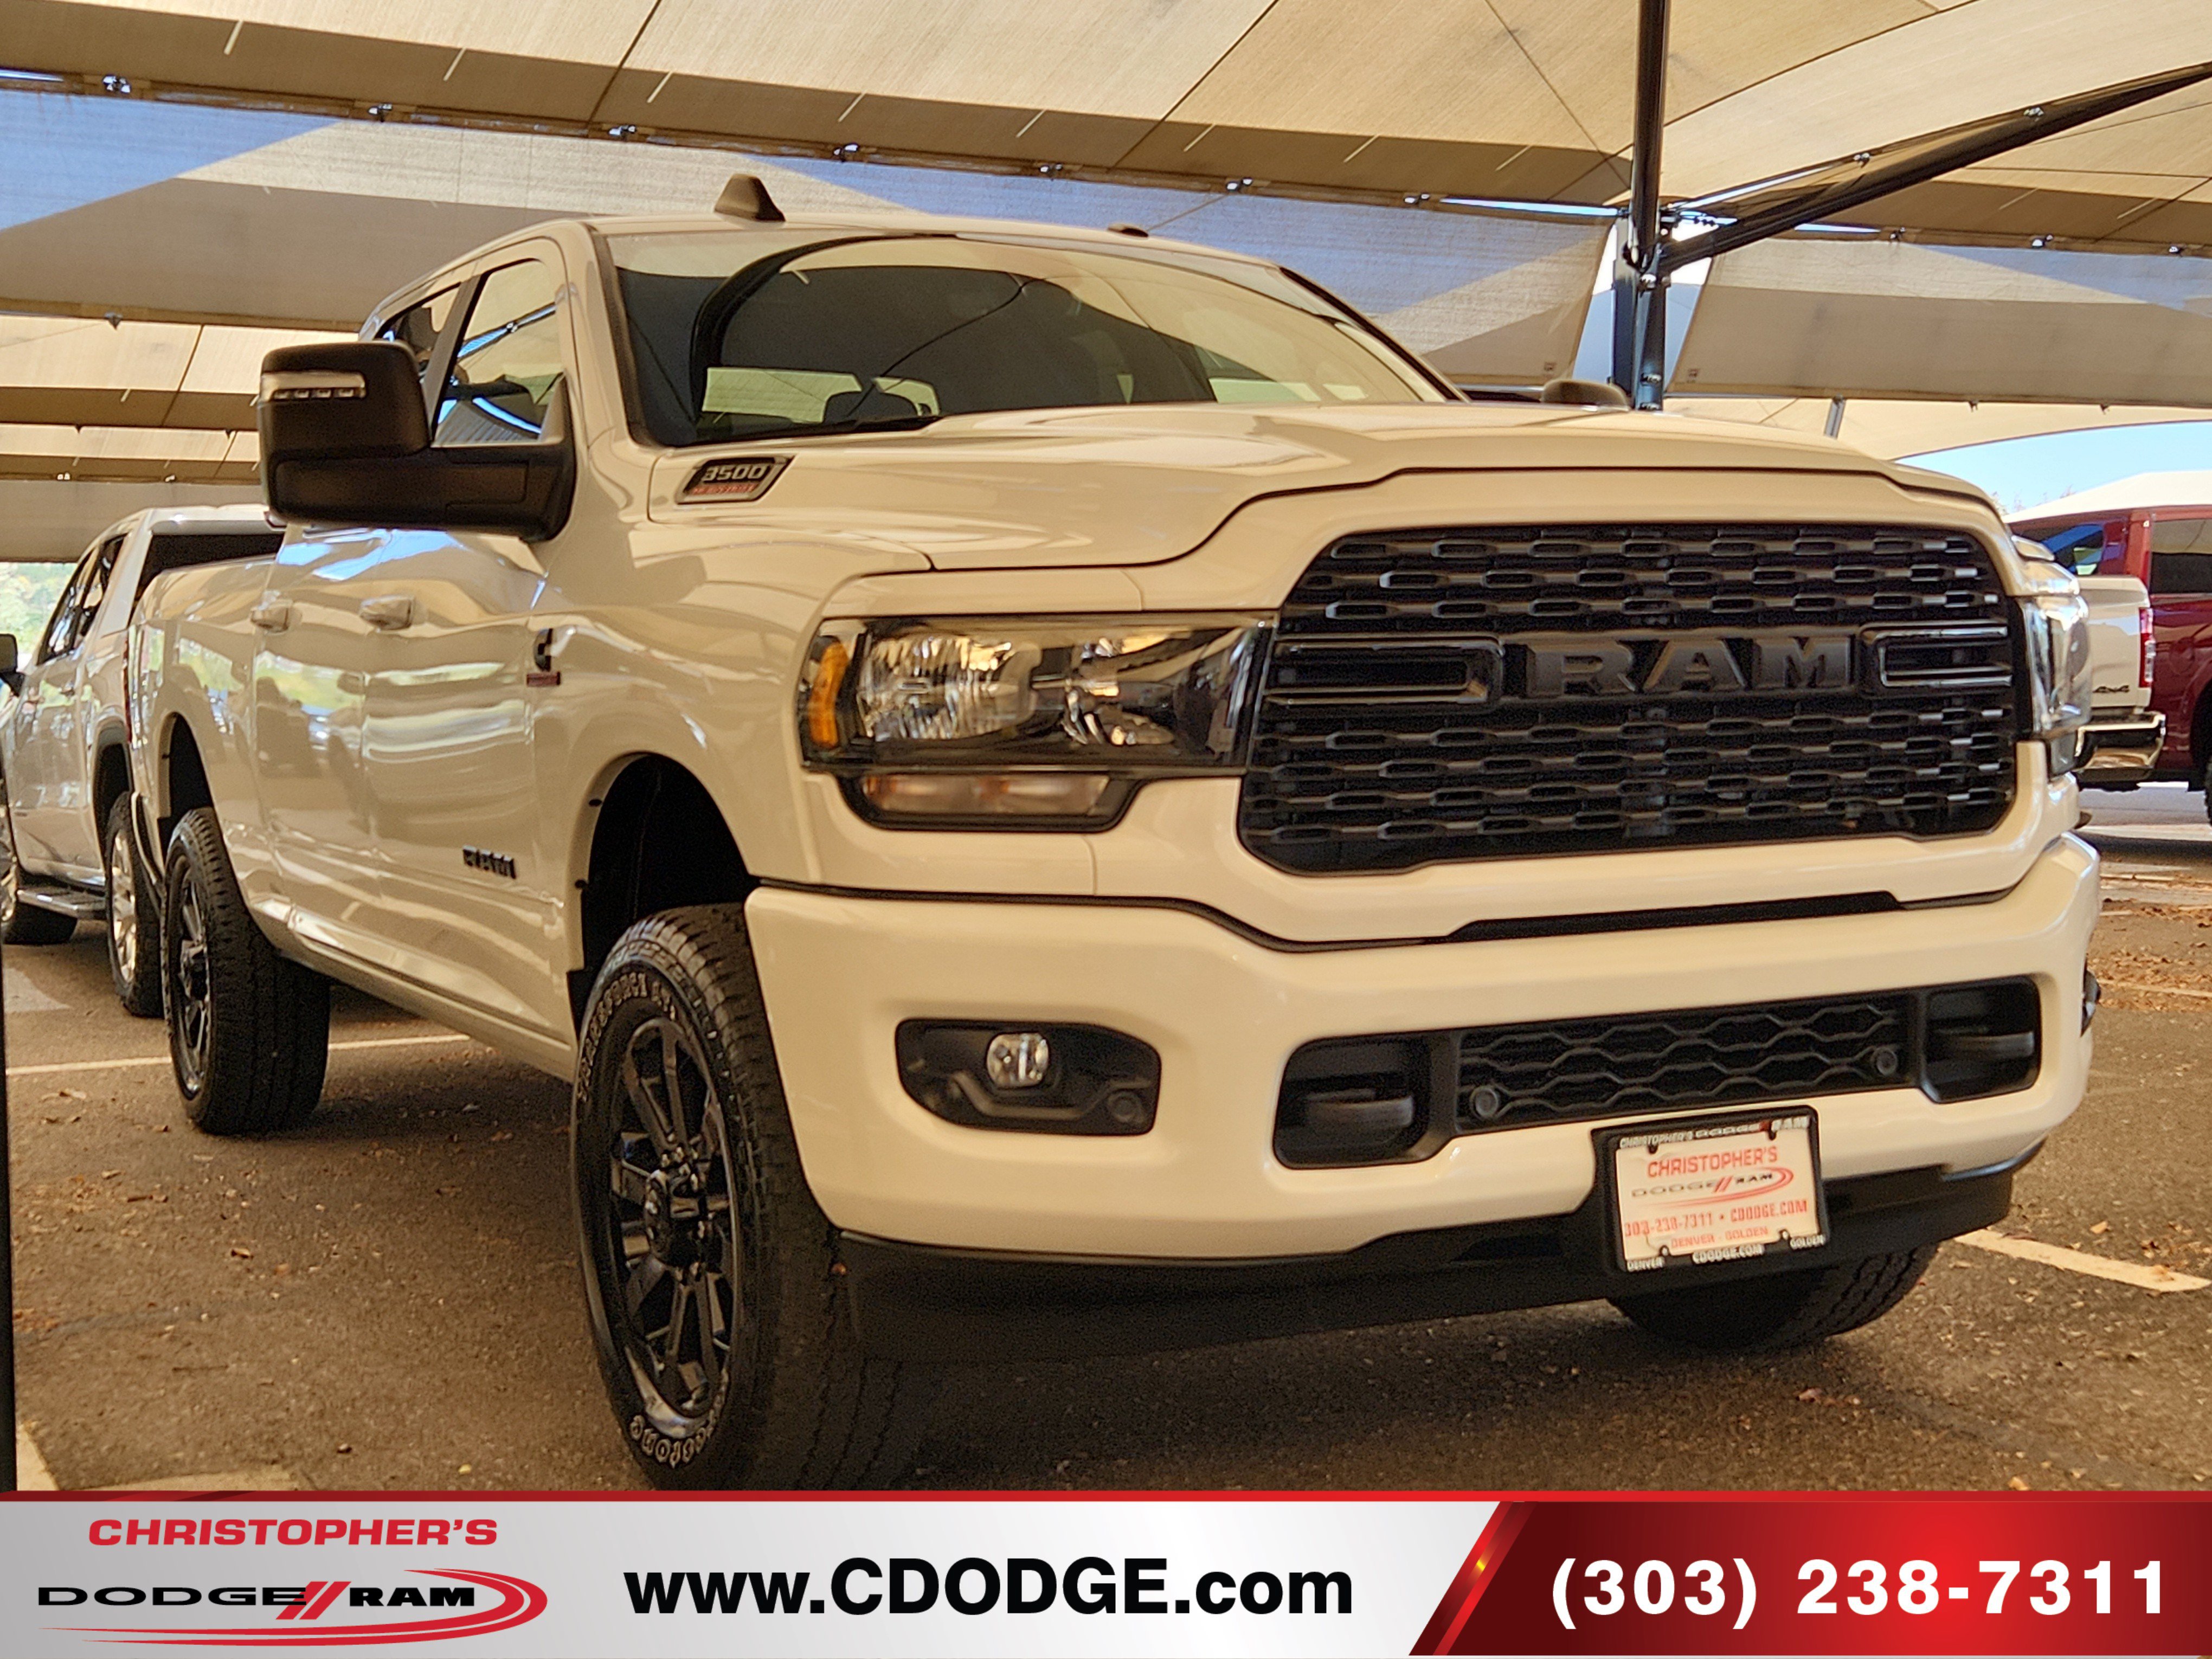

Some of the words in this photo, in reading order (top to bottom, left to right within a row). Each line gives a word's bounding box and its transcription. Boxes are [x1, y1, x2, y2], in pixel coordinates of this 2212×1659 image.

[702, 465, 767, 481] 3500
[1526, 636, 1851, 696] RAM
[1647, 1145, 1778, 1178] CHRISTOPHER'S
[1631, 1180, 1718, 1198] DODGE
[1735, 1172, 1773, 1185] RAM
[1625, 1213, 1713, 1237] 303-238-7311
[1731, 1199, 1808, 1221] CDODGE.COM
[1670, 1233, 1715, 1248] DENVER
[1725, 1225, 1769, 1241] GOLDEN
[1692, 1244, 1765, 1264] CDODGE.COM
